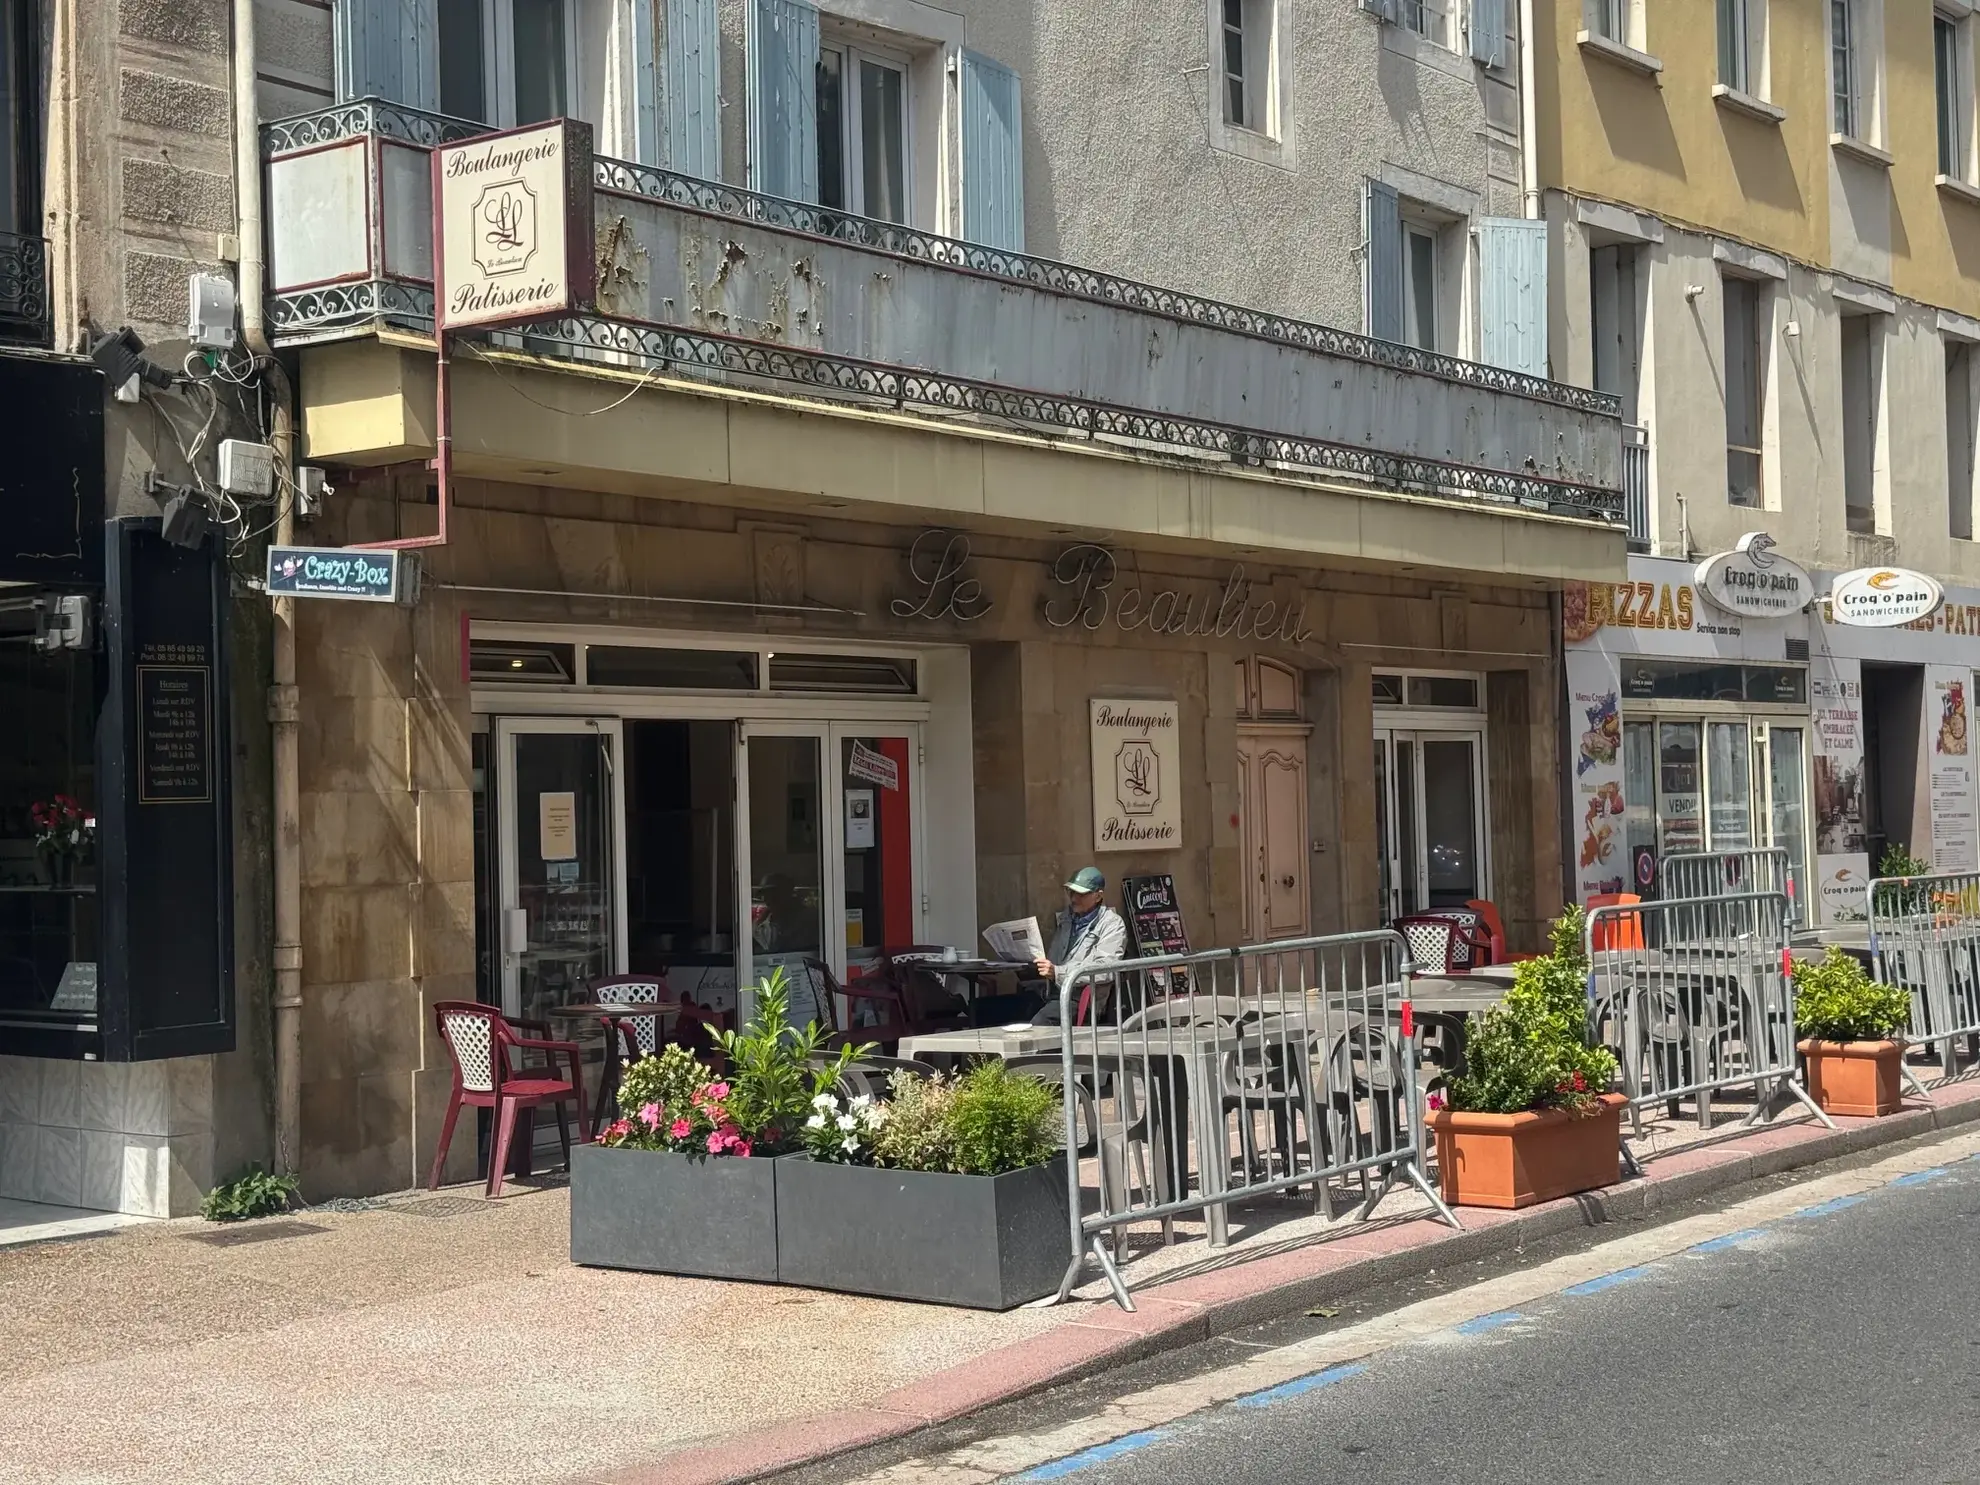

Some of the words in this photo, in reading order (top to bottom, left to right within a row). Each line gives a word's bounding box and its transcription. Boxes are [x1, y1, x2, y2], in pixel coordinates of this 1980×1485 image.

[447, 138, 559, 178] Boulangerie
[451, 278, 560, 314] Patisserie
[304, 556, 389, 585] Crazy-Box
[891, 529, 993, 621] Le
[1045, 544, 1312, 642] Beaulieu
[1585, 581, 1694, 631] PIZZAS
[1736, 595, 1787, 608] SANDWICHERIE
[1850, 606, 1920, 617] SANDWICHERIE
[1697, 622, 1717, 634] Service
[1717, 626, 1728, 634] non
[1729, 626, 1741, 638] stop
[1096, 705, 1173, 736] Boulangerie
[1824, 738, 1833, 748] ET
[1834, 738, 1853, 748] CALME
[1102, 817, 1175, 841] Patisserie
